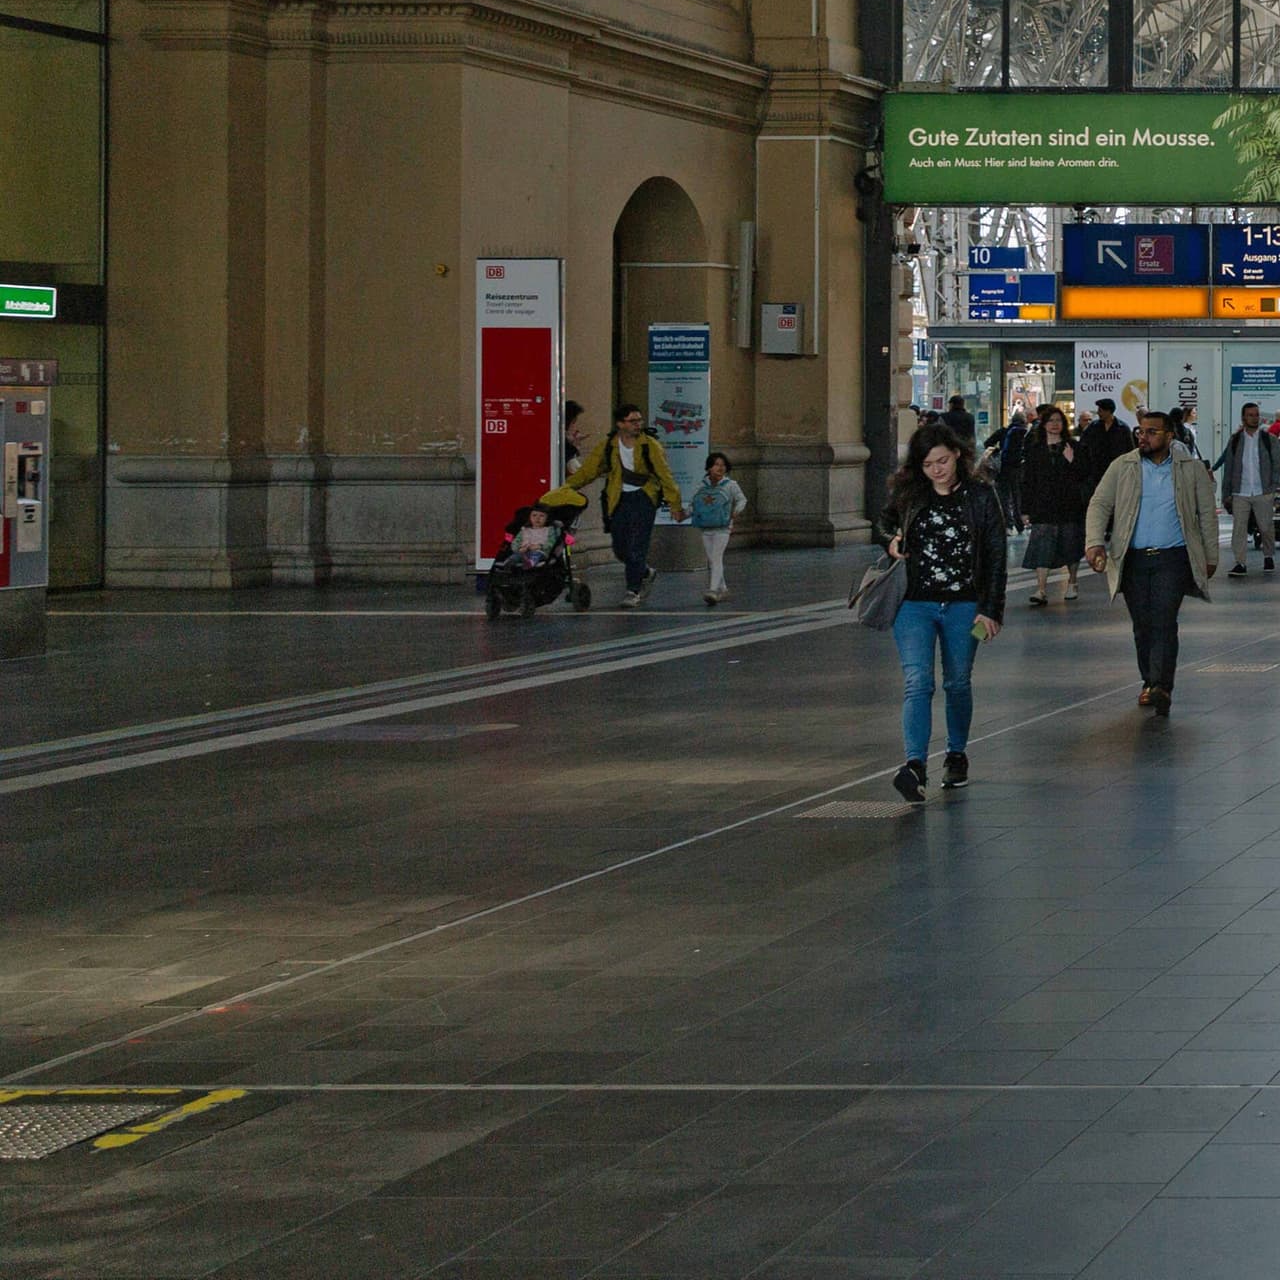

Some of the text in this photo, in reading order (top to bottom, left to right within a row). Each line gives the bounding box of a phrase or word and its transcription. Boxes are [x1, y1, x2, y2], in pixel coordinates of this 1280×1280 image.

[907, 126, 1216, 147] Gute Zutaten sind ein Mousse.
[909, 156, 1120, 168] Auch ein Muss: Hier sind keine Aromen drin.
[971, 248, 991, 264] 10
[1243, 254, 1277, 263] Ausgang
[1138, 260, 1161, 268] Ersatz
[1080, 349, 1108, 359] 100%
[1080, 360, 1122, 369] Arabica
[1080, 370, 1122, 382] Organic
[1080, 382, 1115, 392] Coffee
[487, 420, 506, 432] DB
